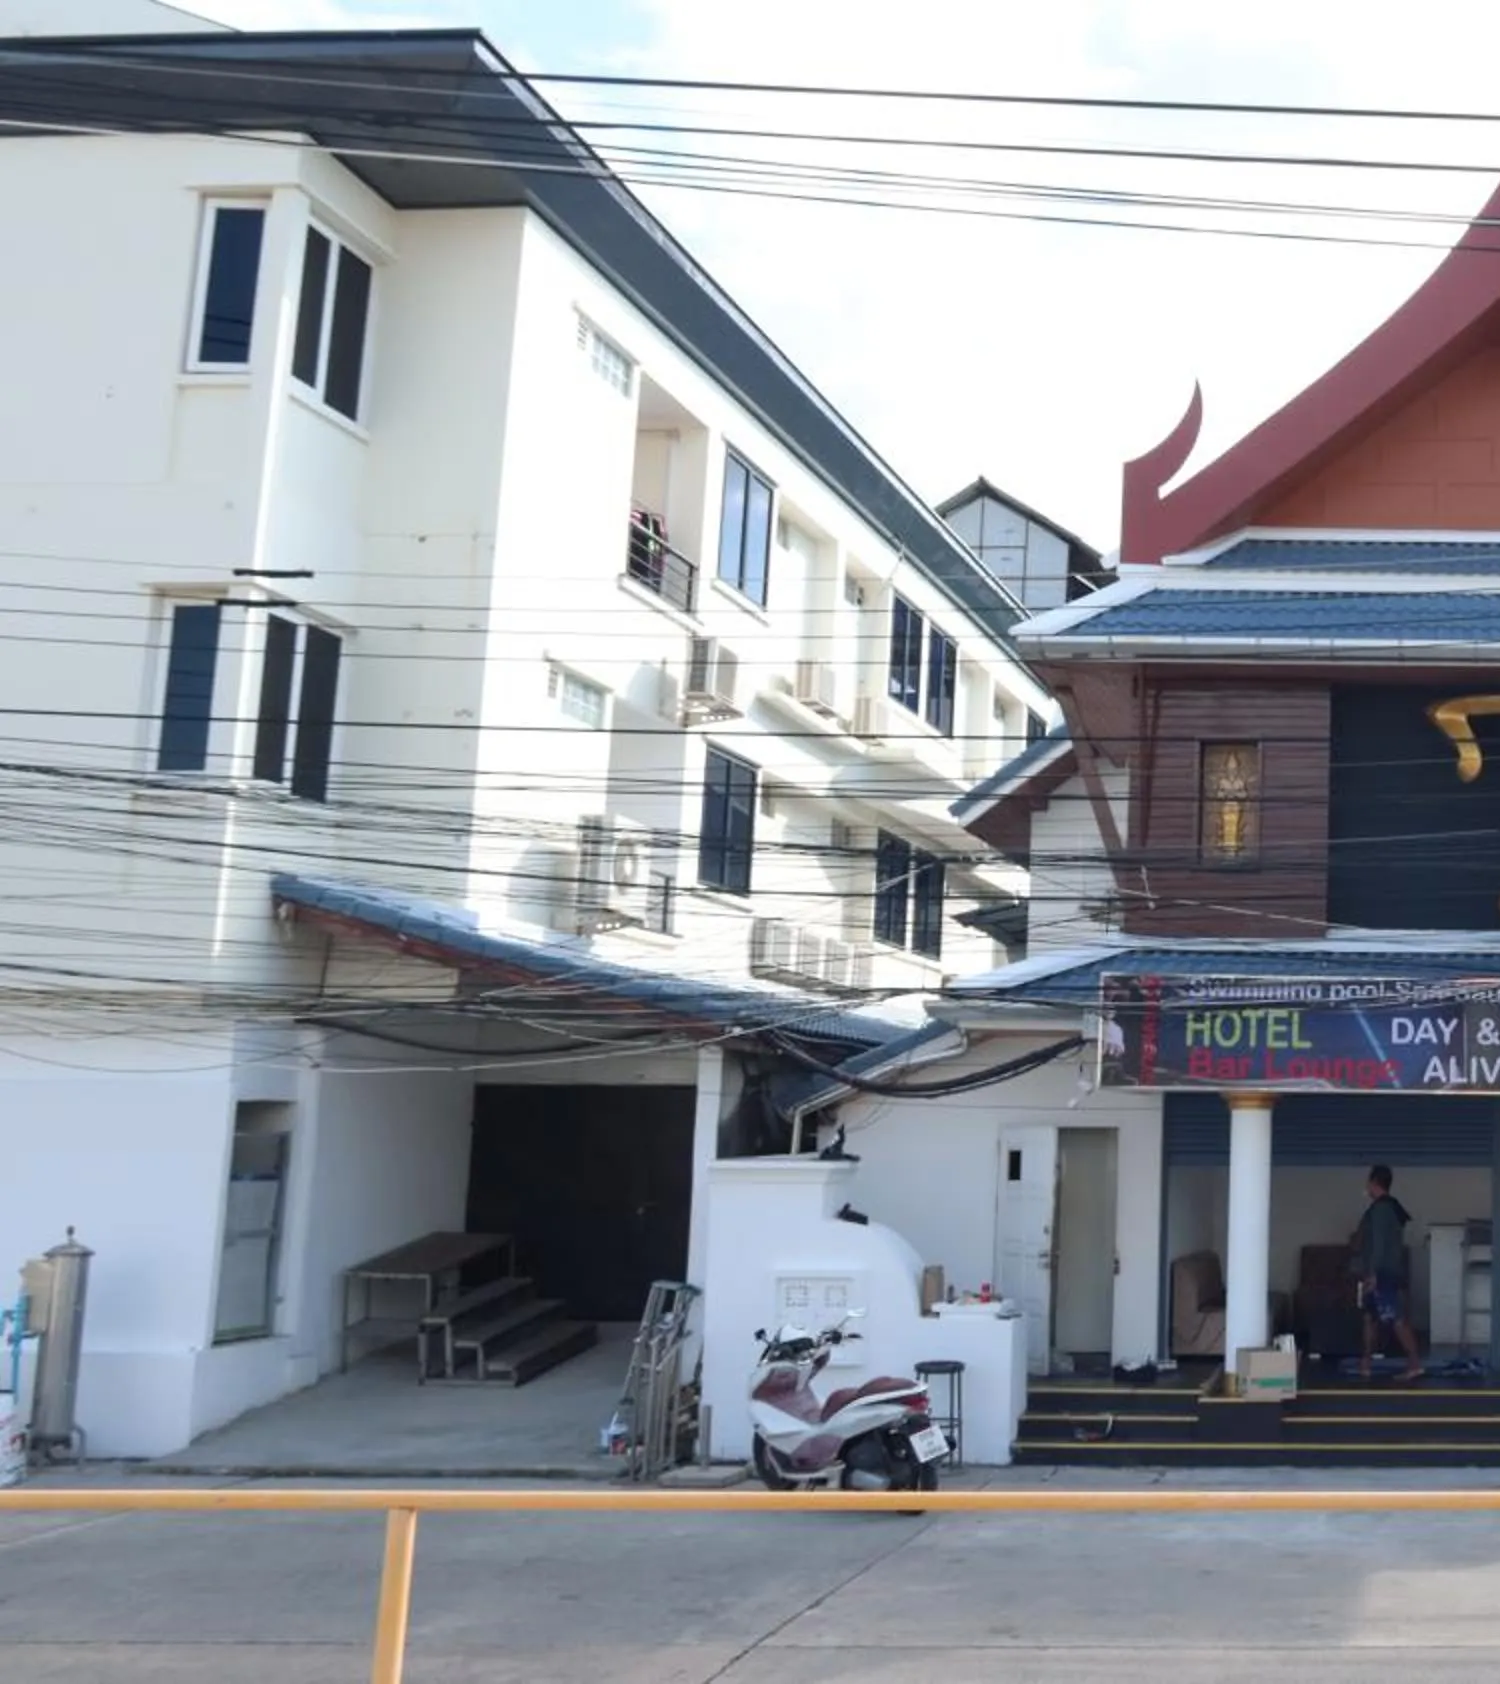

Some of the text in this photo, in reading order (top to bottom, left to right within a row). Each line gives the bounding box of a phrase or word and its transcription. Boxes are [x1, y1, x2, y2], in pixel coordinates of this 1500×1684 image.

[1185, 1008, 1313, 1049] HOTEL
[1390, 1017, 1459, 1046] DAY
[1188, 1048, 1405, 1091] Bar Lounge
